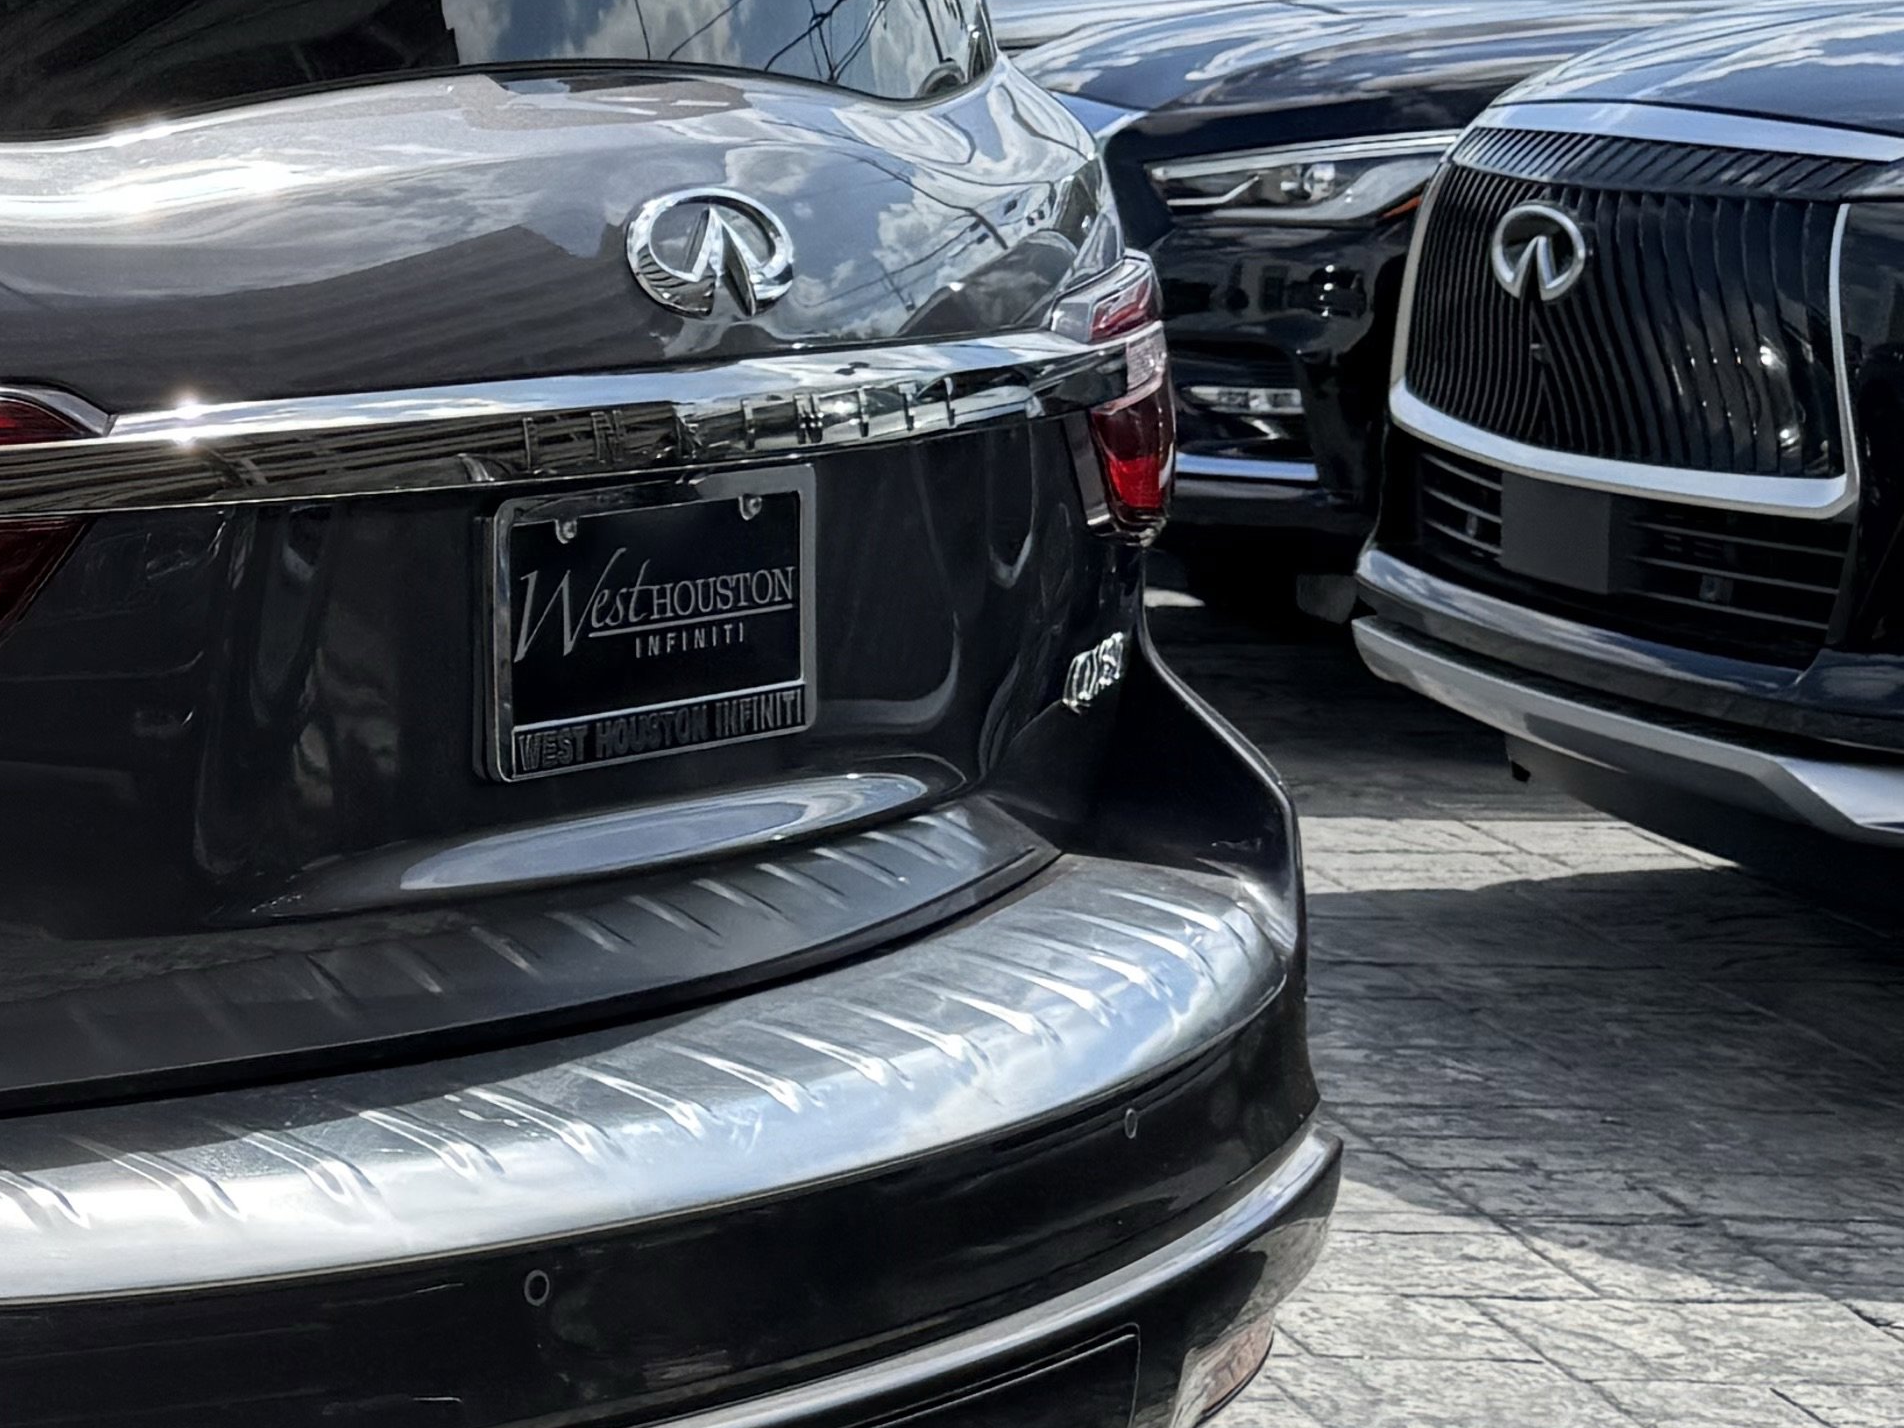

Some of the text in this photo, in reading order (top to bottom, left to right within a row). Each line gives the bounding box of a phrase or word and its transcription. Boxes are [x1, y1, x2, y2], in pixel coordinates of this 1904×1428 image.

[651, 565, 795, 620] HOUSTON
[634, 622, 747, 659] INFINITI
[518, 688, 804, 772] WEST HOUSTON INFINITI
